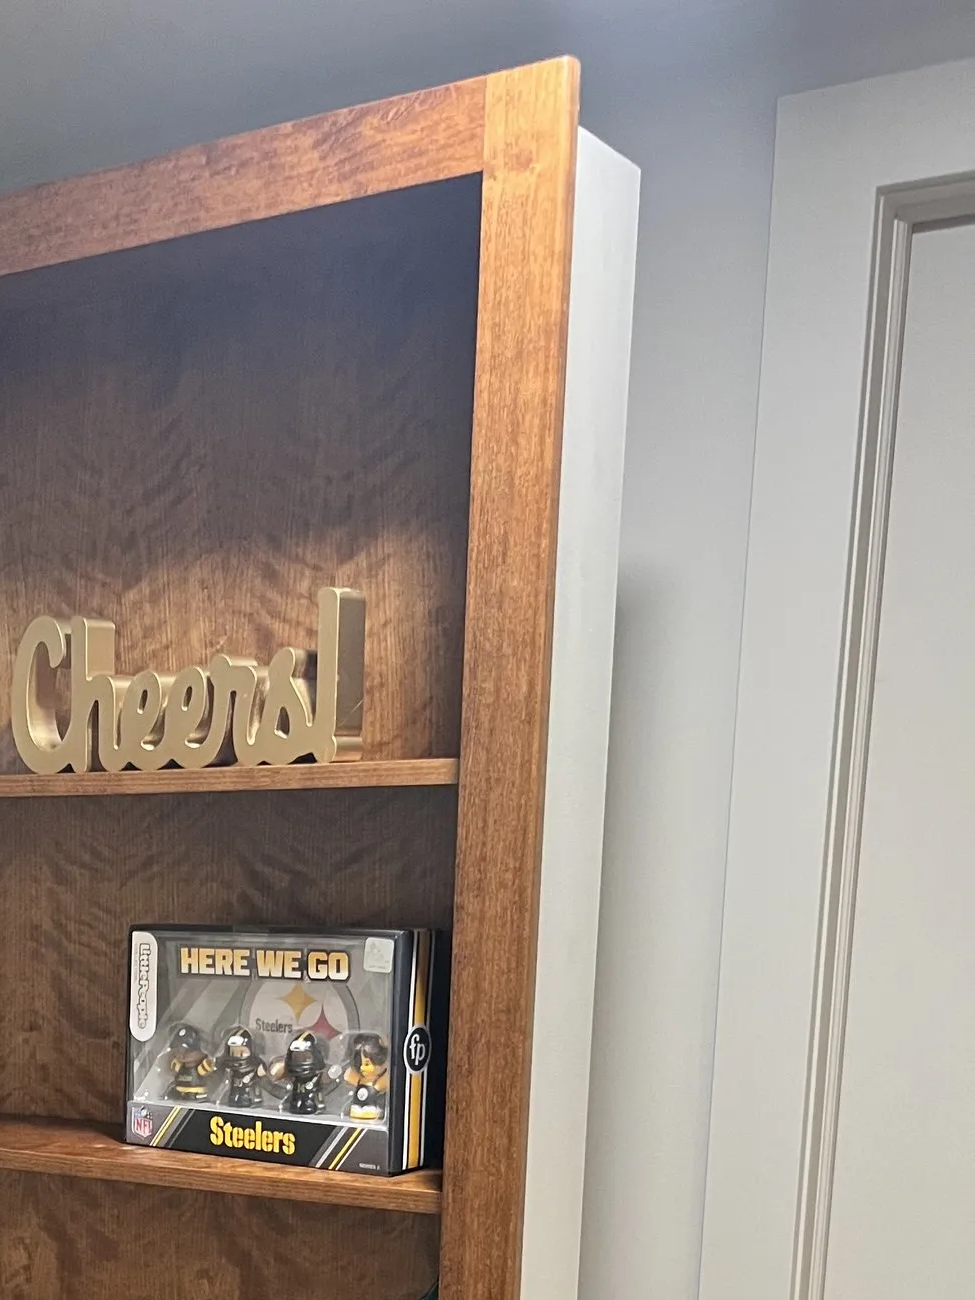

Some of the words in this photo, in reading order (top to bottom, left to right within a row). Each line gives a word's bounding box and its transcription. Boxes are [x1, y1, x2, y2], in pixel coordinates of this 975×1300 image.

[11, 587, 365, 775] Cheers!
[179, 946, 251, 977] HERE
[256, 949, 302, 979] WE
[307, 951, 350, 981] GO
[255, 1017, 293, 1034] Steelers
[408, 1033, 426, 1066] fp
[209, 1115, 296, 1155] Steelers
